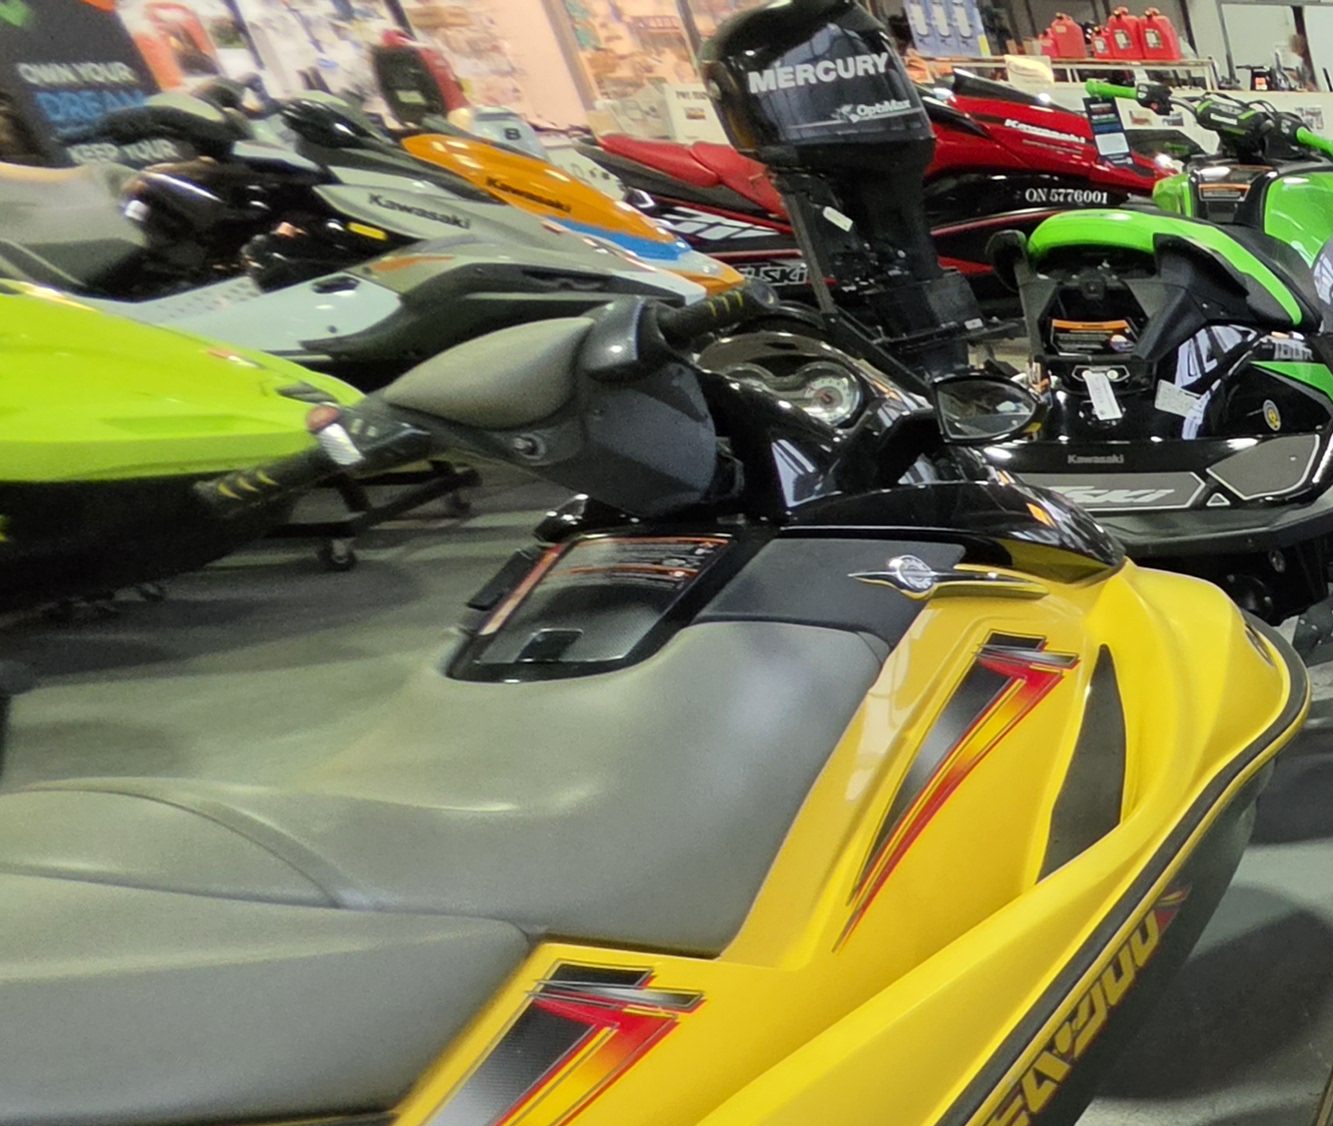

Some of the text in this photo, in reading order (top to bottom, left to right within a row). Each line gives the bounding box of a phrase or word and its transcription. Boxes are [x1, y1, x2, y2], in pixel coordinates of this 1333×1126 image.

[71, 61, 138, 83] YOUR
[748, 52, 889, 93] MERCURY
[1024, 187, 1108, 204] ON 5776001
[369, 192, 470, 230] Kawasaki
[1067, 453, 1125, 465] Kawasaki
